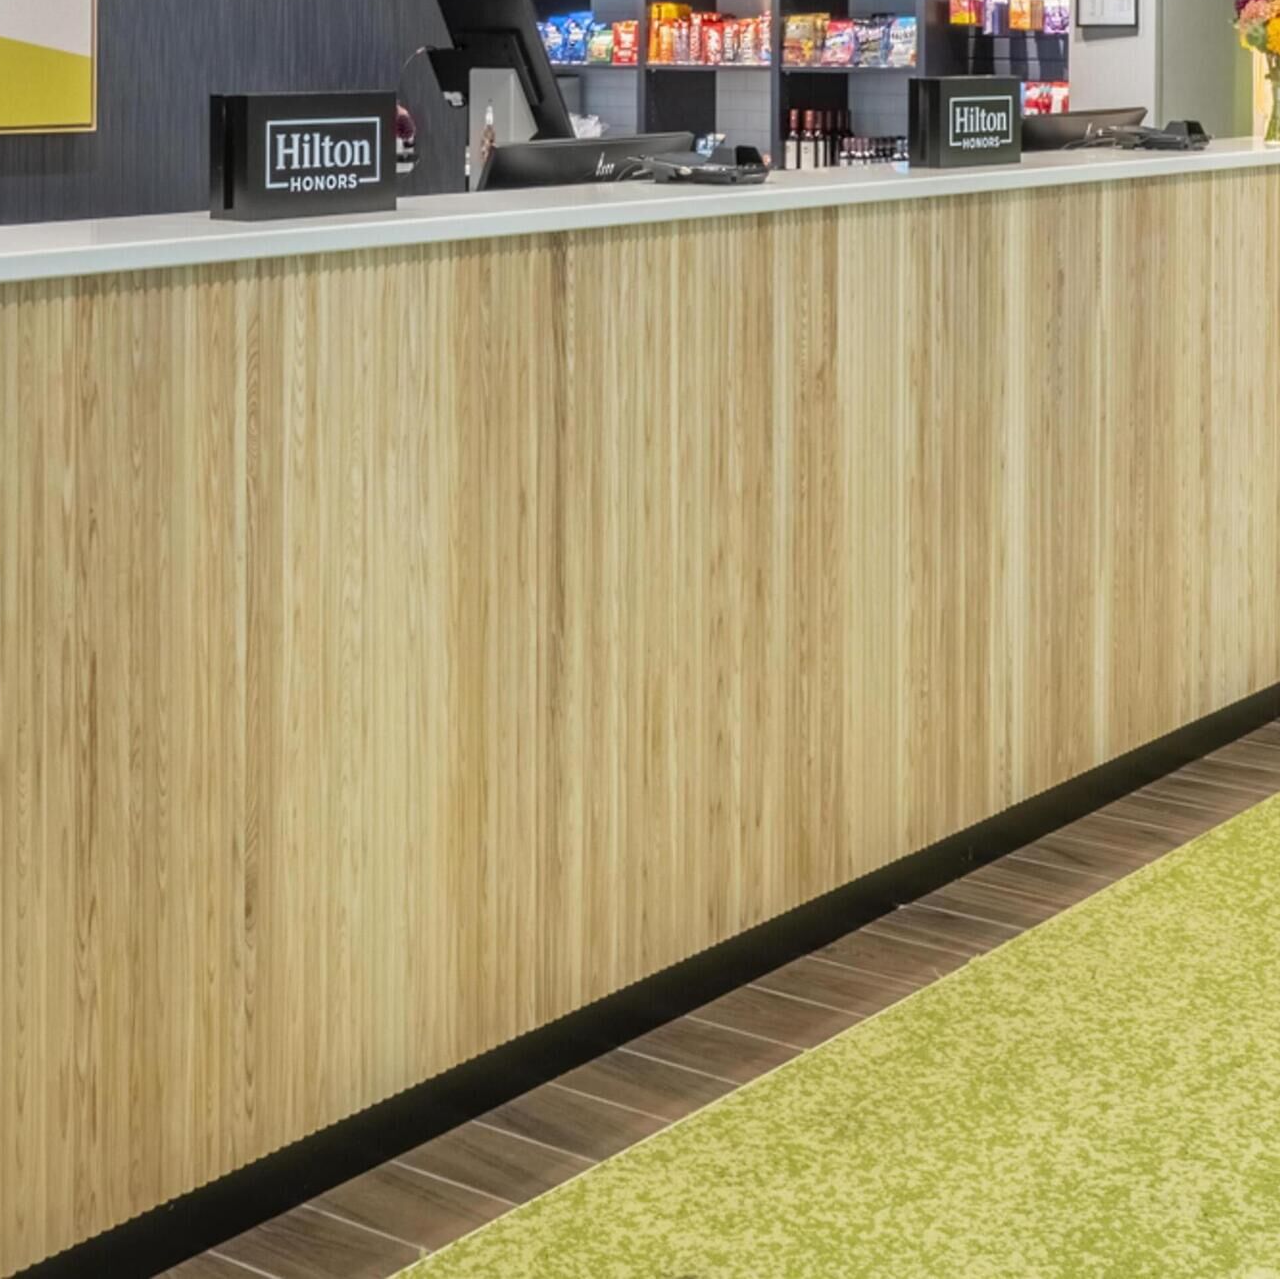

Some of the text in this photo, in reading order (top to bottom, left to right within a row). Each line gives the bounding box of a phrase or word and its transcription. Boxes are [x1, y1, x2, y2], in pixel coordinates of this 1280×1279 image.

[955, 106, 1007, 133] Hilton
[275, 132, 371, 170] Hilton
[962, 135, 1000, 150] HONORS
[289, 173, 358, 192] HONORS
